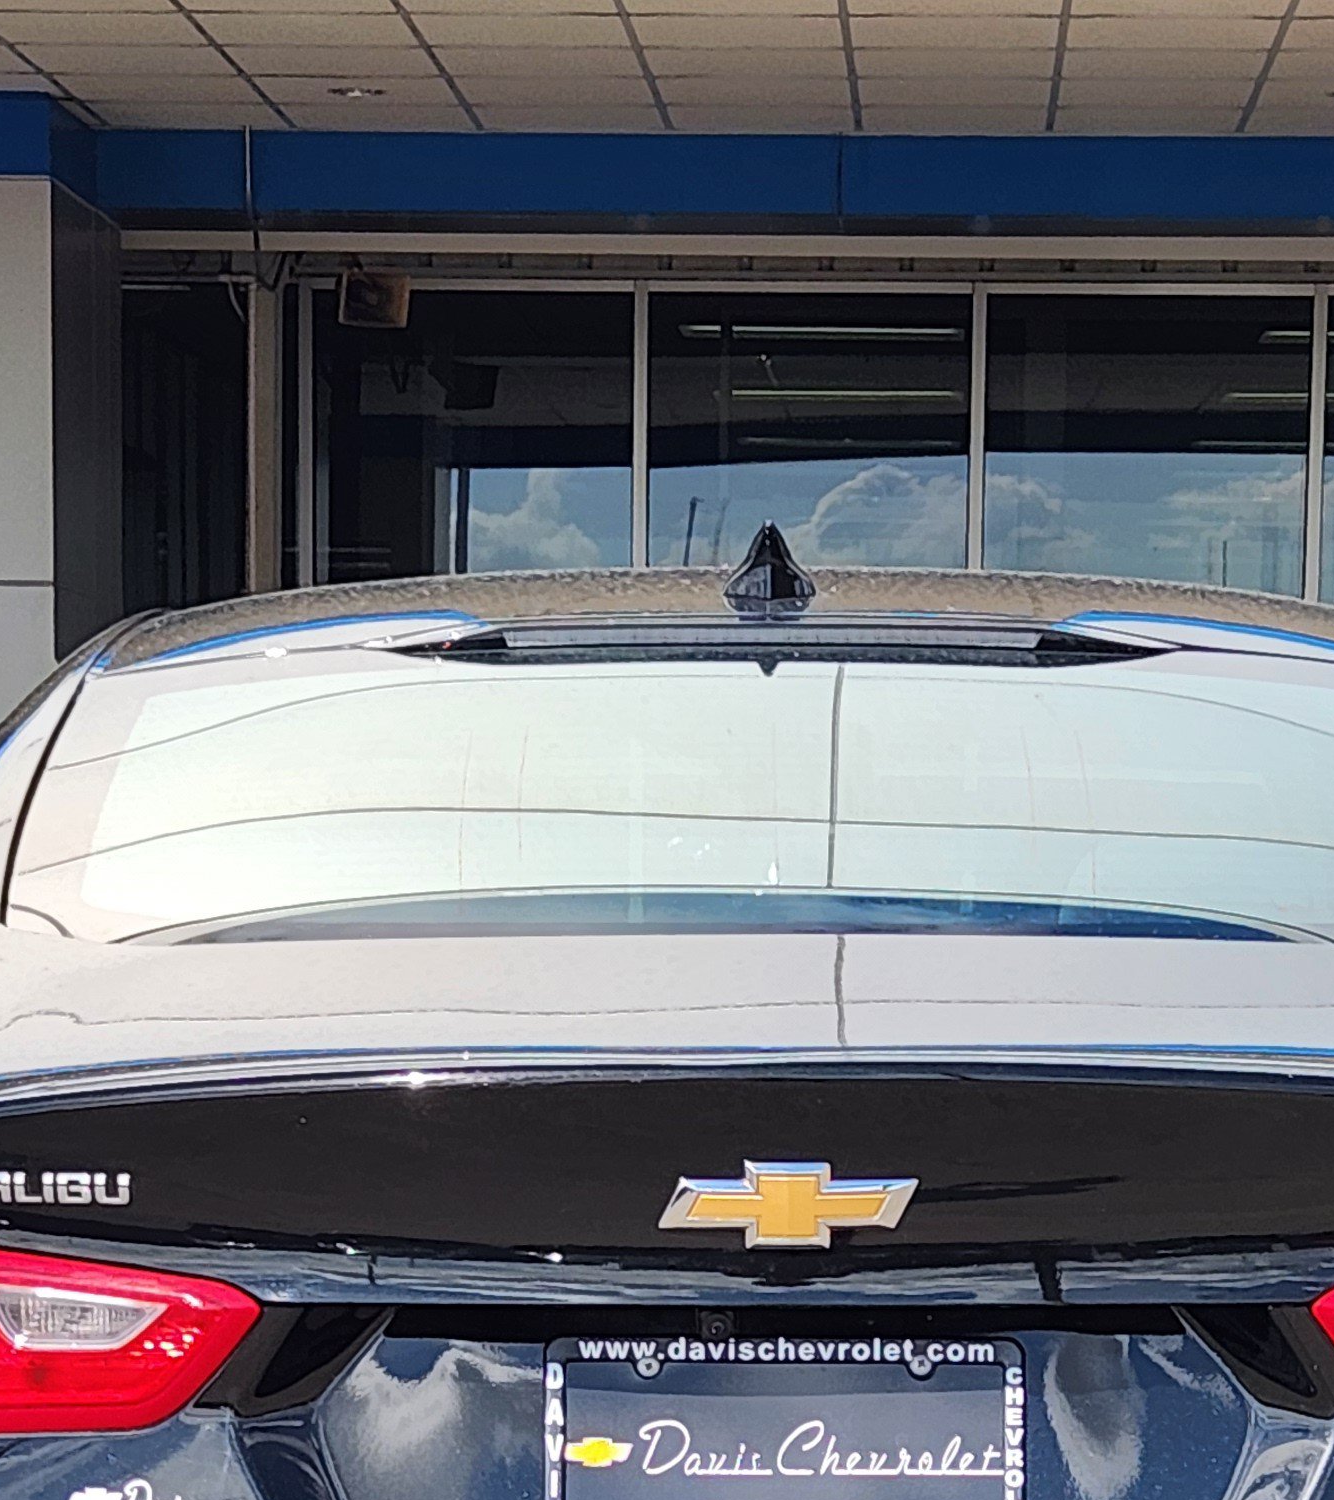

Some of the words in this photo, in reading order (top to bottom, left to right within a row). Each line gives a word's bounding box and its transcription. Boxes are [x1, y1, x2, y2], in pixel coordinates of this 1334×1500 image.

[578, 1336, 995, 1361] www.davischevroletcom
[638, 1419, 773, 1476] Davis
[776, 1420, 1005, 1476] Chevrolet
